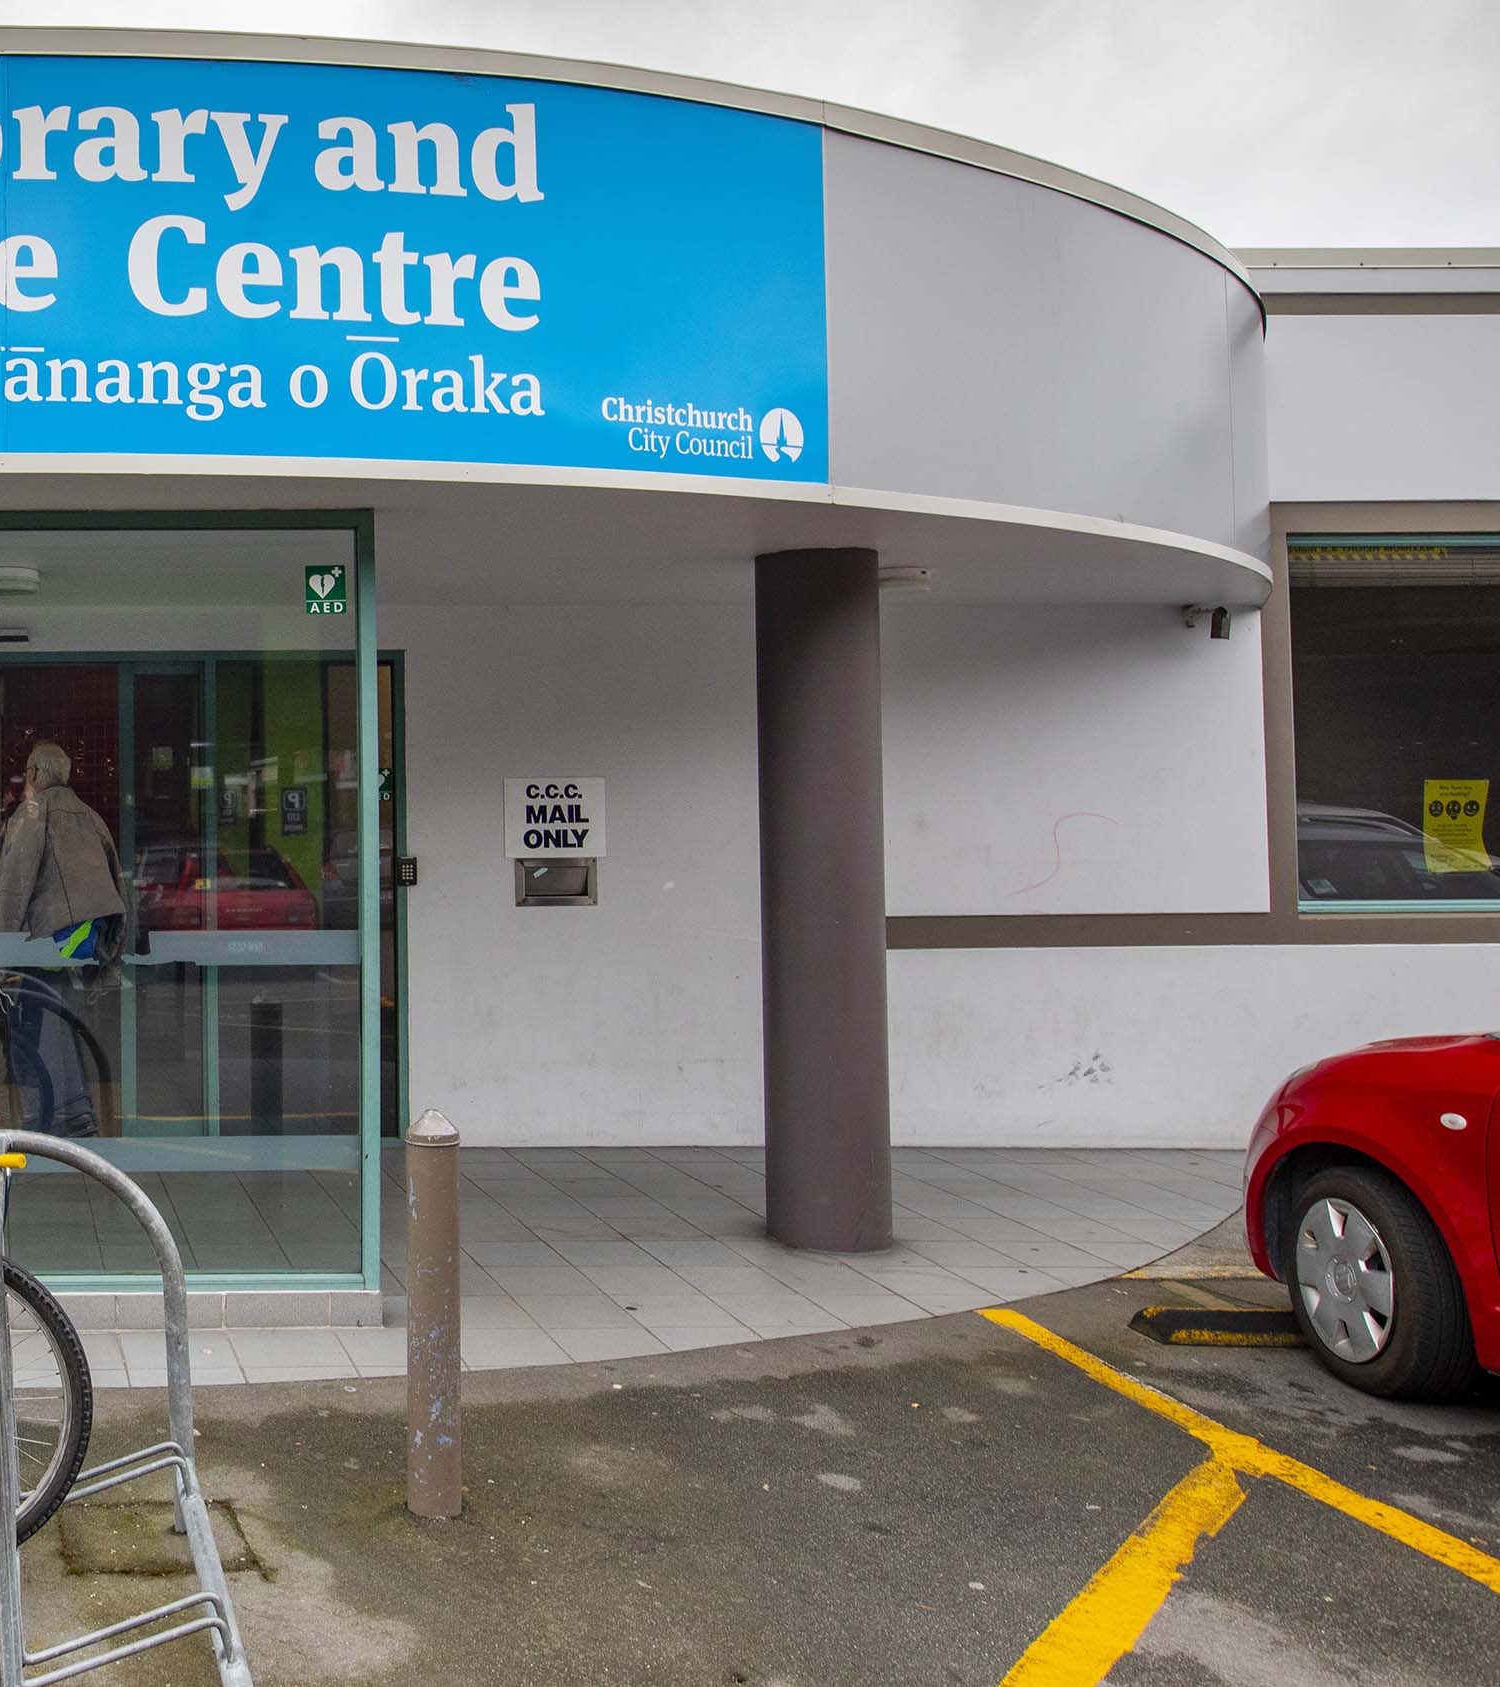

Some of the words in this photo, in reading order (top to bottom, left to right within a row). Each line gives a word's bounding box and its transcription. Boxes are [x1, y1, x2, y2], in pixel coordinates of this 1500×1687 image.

[315, 104, 544, 203] and
[128, 215, 540, 331] Centre
[290, 365, 327, 408] o
[347, 336, 545, 416] Ōraka
[601, 396, 754, 432] Christchurch
[628, 427, 670, 458] City
[675, 430, 754, 459] Council
[310, 602, 343, 613] AED
[525, 784, 583, 799] C.C.C.
[525, 804, 589, 824] MAIL
[523, 829, 589, 849] ONLY
